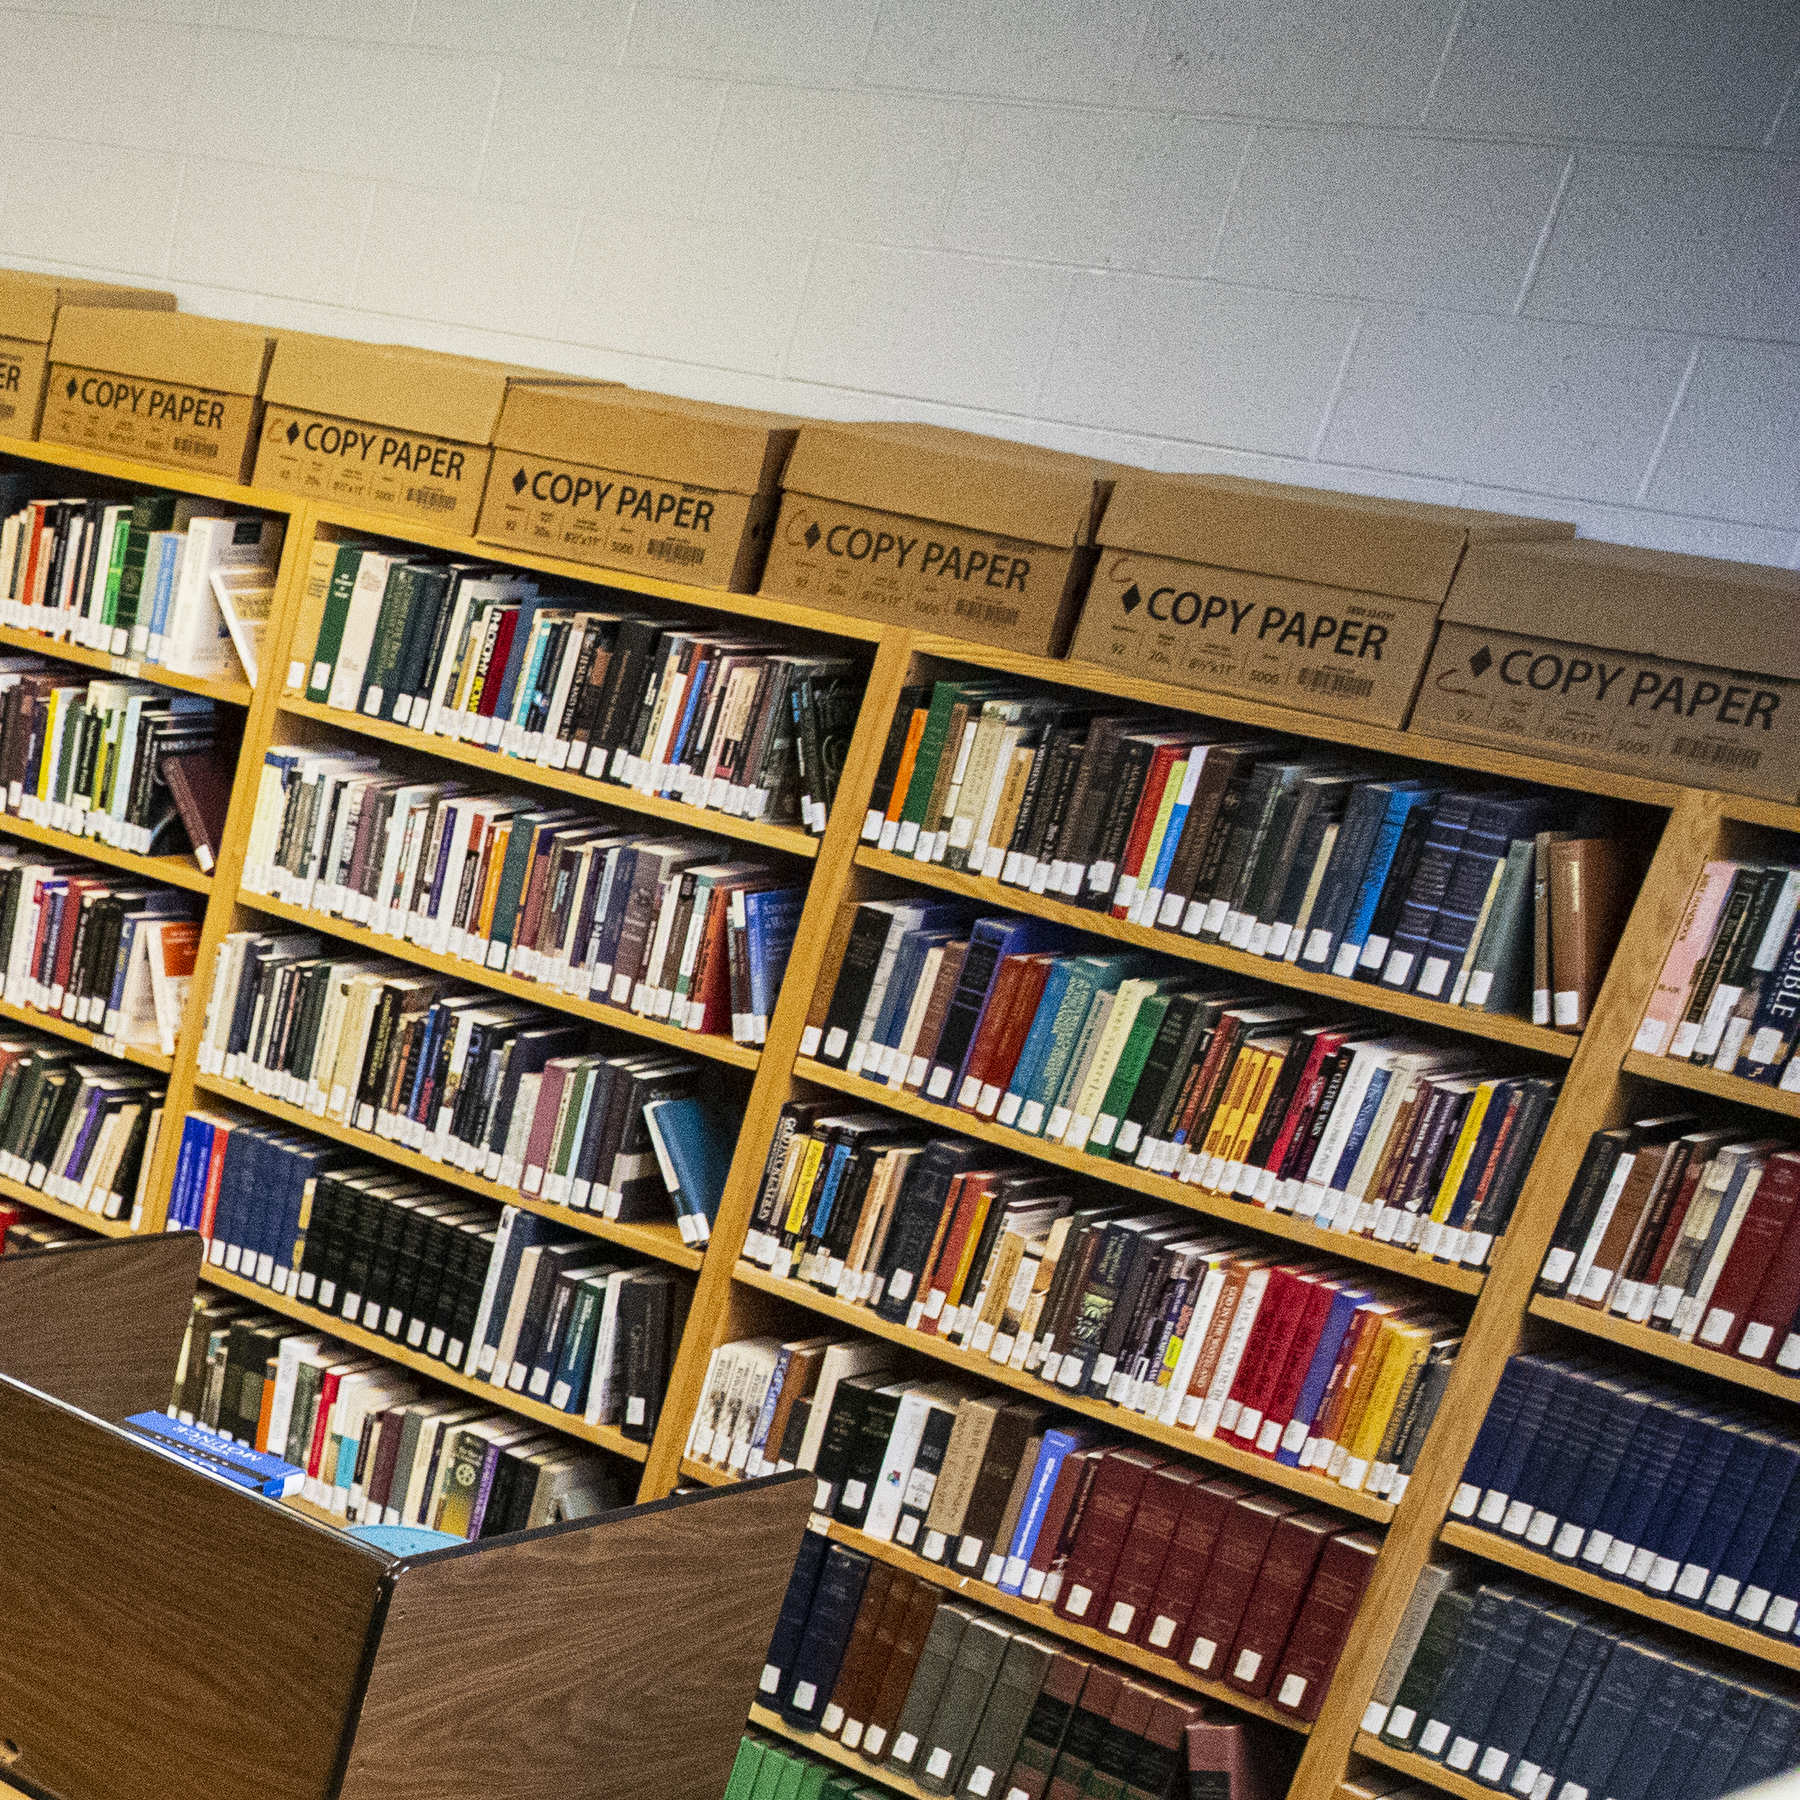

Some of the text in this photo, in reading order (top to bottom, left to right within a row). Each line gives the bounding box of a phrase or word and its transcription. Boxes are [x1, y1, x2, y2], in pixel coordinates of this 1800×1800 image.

[82, 378, 224, 429] COPY PAPER
[304, 421, 465, 481] COPY PAPER
[532, 472, 714, 533] COPY PAPER
[826, 524, 1031, 592] COPY PAPER
[474, 609, 502, 676] PHILOSOPHY
[1146, 587, 1390, 660] COPY PAPER
[561, 654, 589, 726] JESUS AND THE
[1499, 650, 1781, 731] COPY PAPER
[1096, 1233, 1119, 1276] Theology
[1104, 1231, 1130, 1285] Evangelical
[1195, 1284, 1238, 1389] GOD IN THE WASTELAND
[1212, 1294, 1256, 1403] NO PLACE FOR TRUTH
